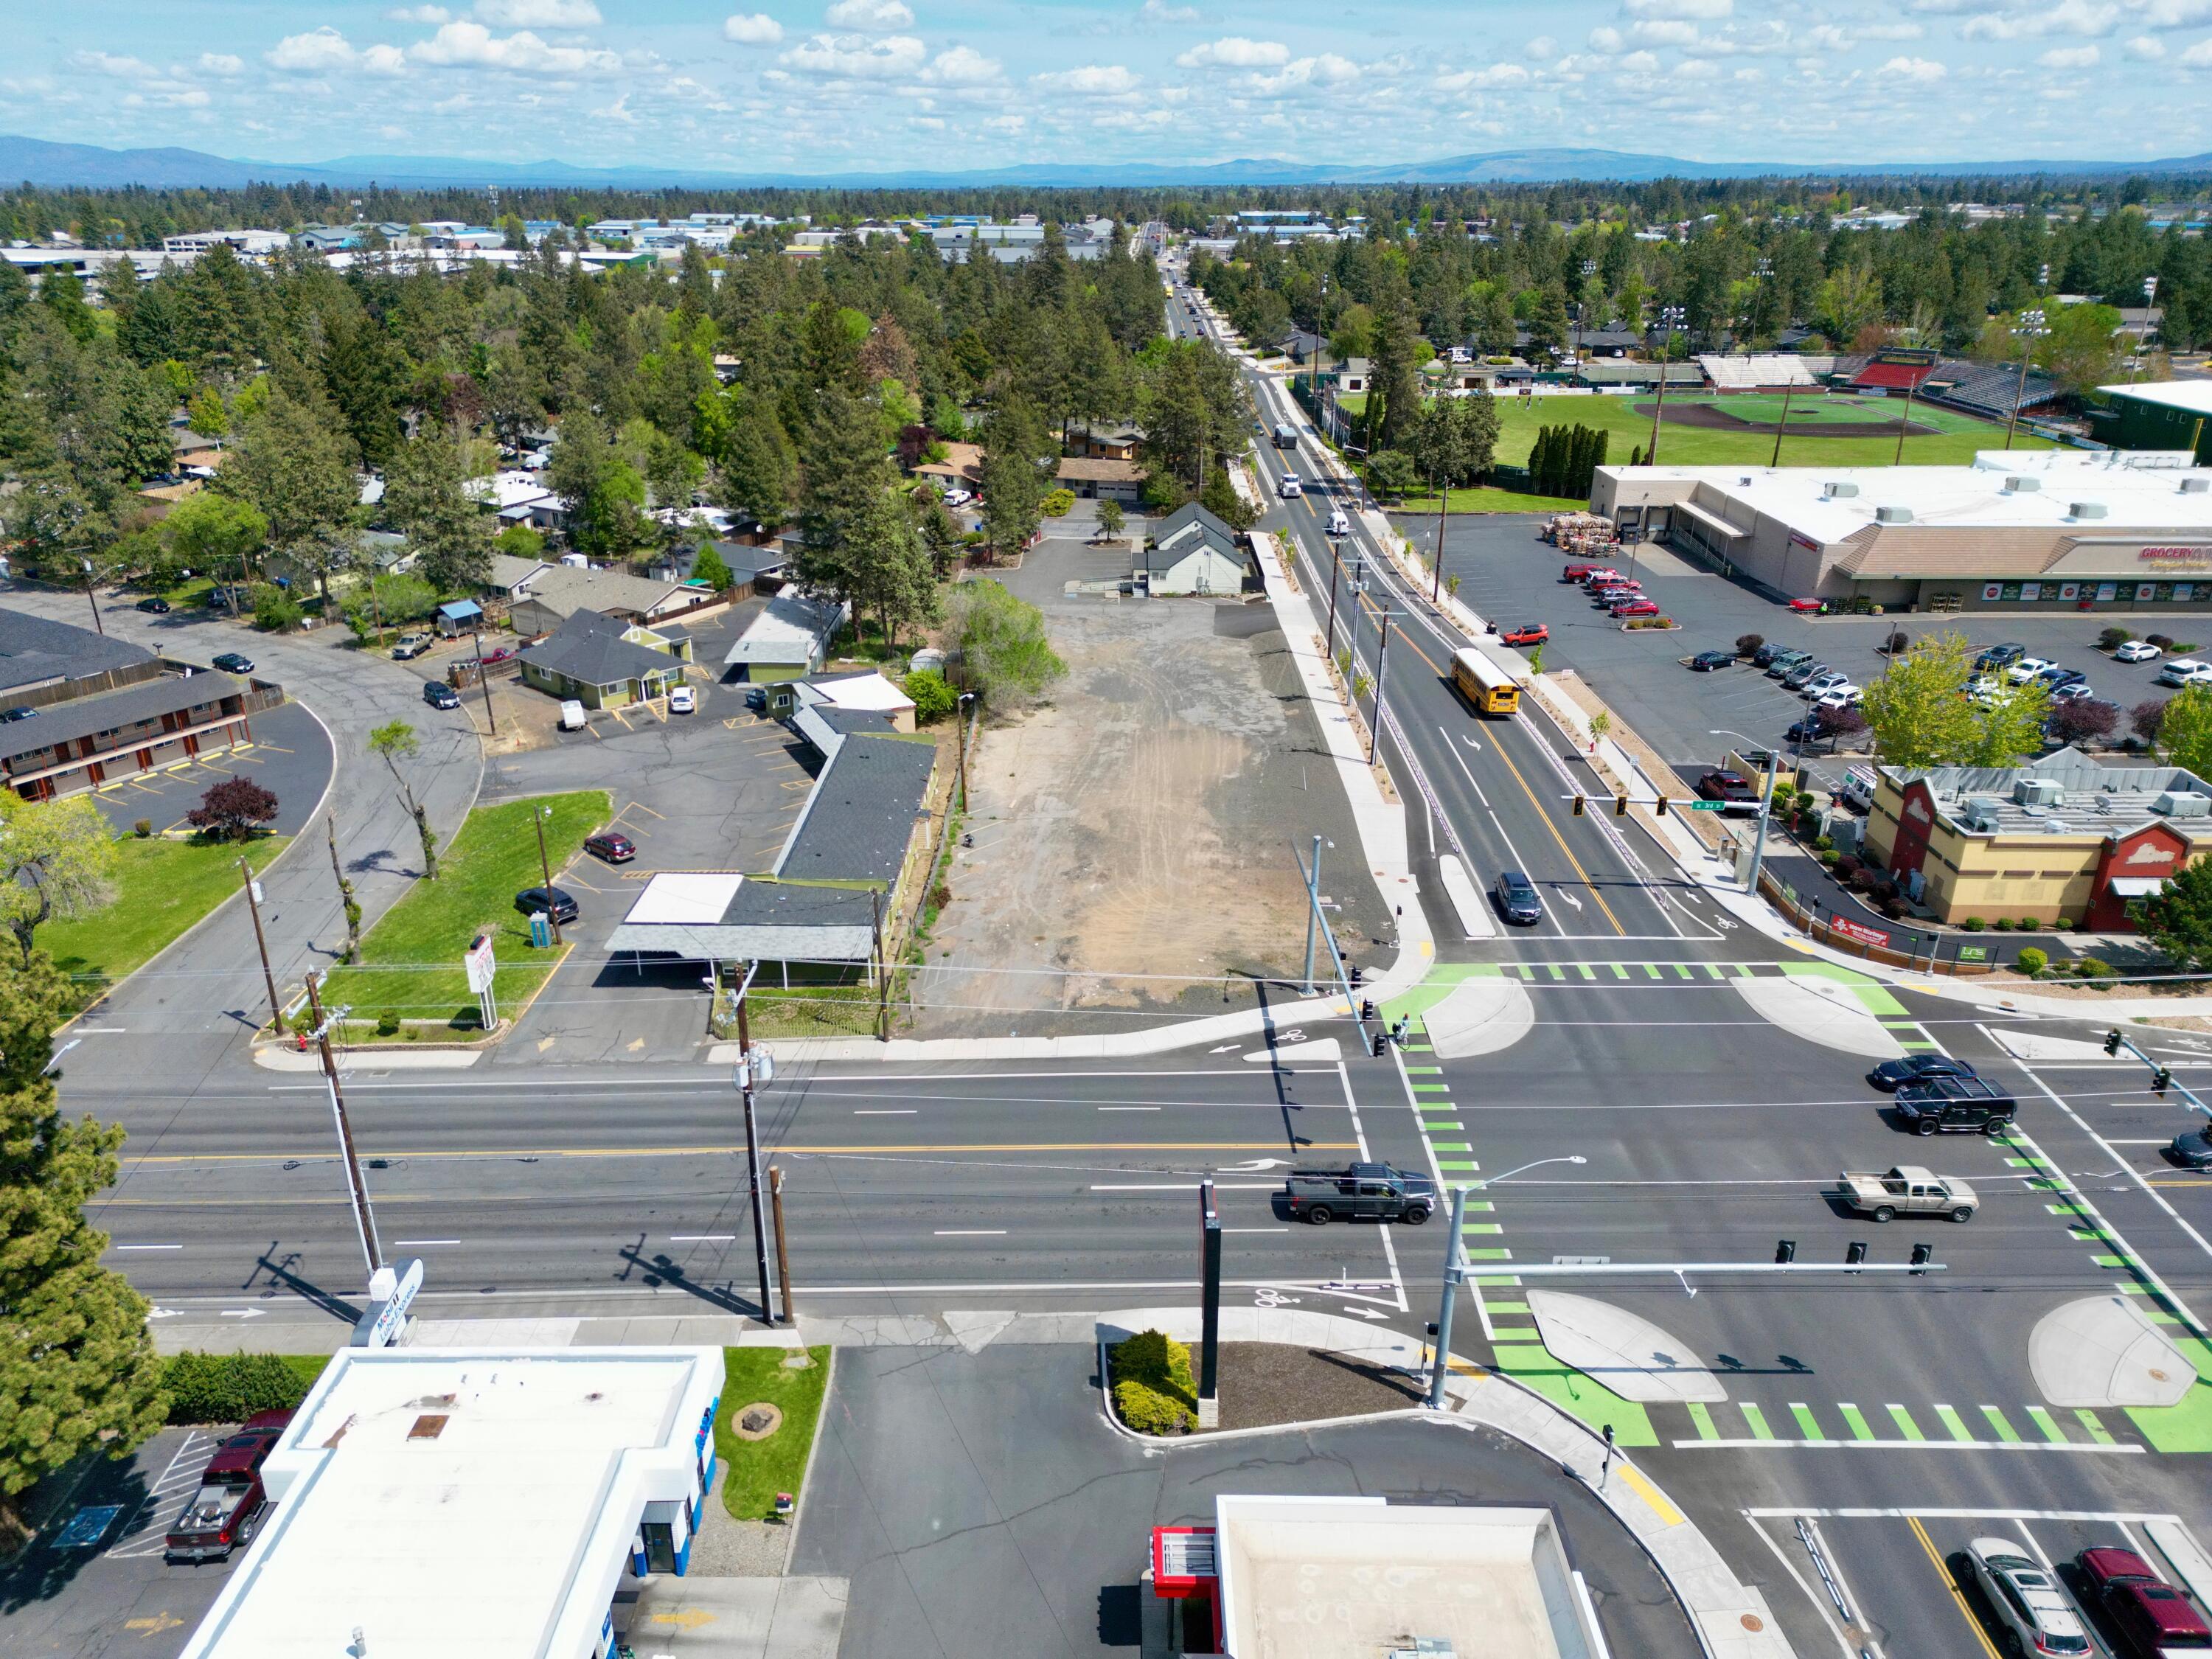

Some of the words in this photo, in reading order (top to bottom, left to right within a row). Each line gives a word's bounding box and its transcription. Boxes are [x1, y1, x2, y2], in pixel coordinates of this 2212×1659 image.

[2141, 547, 2194, 557] GROCERY
[378, 1303, 394, 1331] Mobil
[380, 1317, 394, 1342] Lube
[394, 1283, 415, 1319] Express
